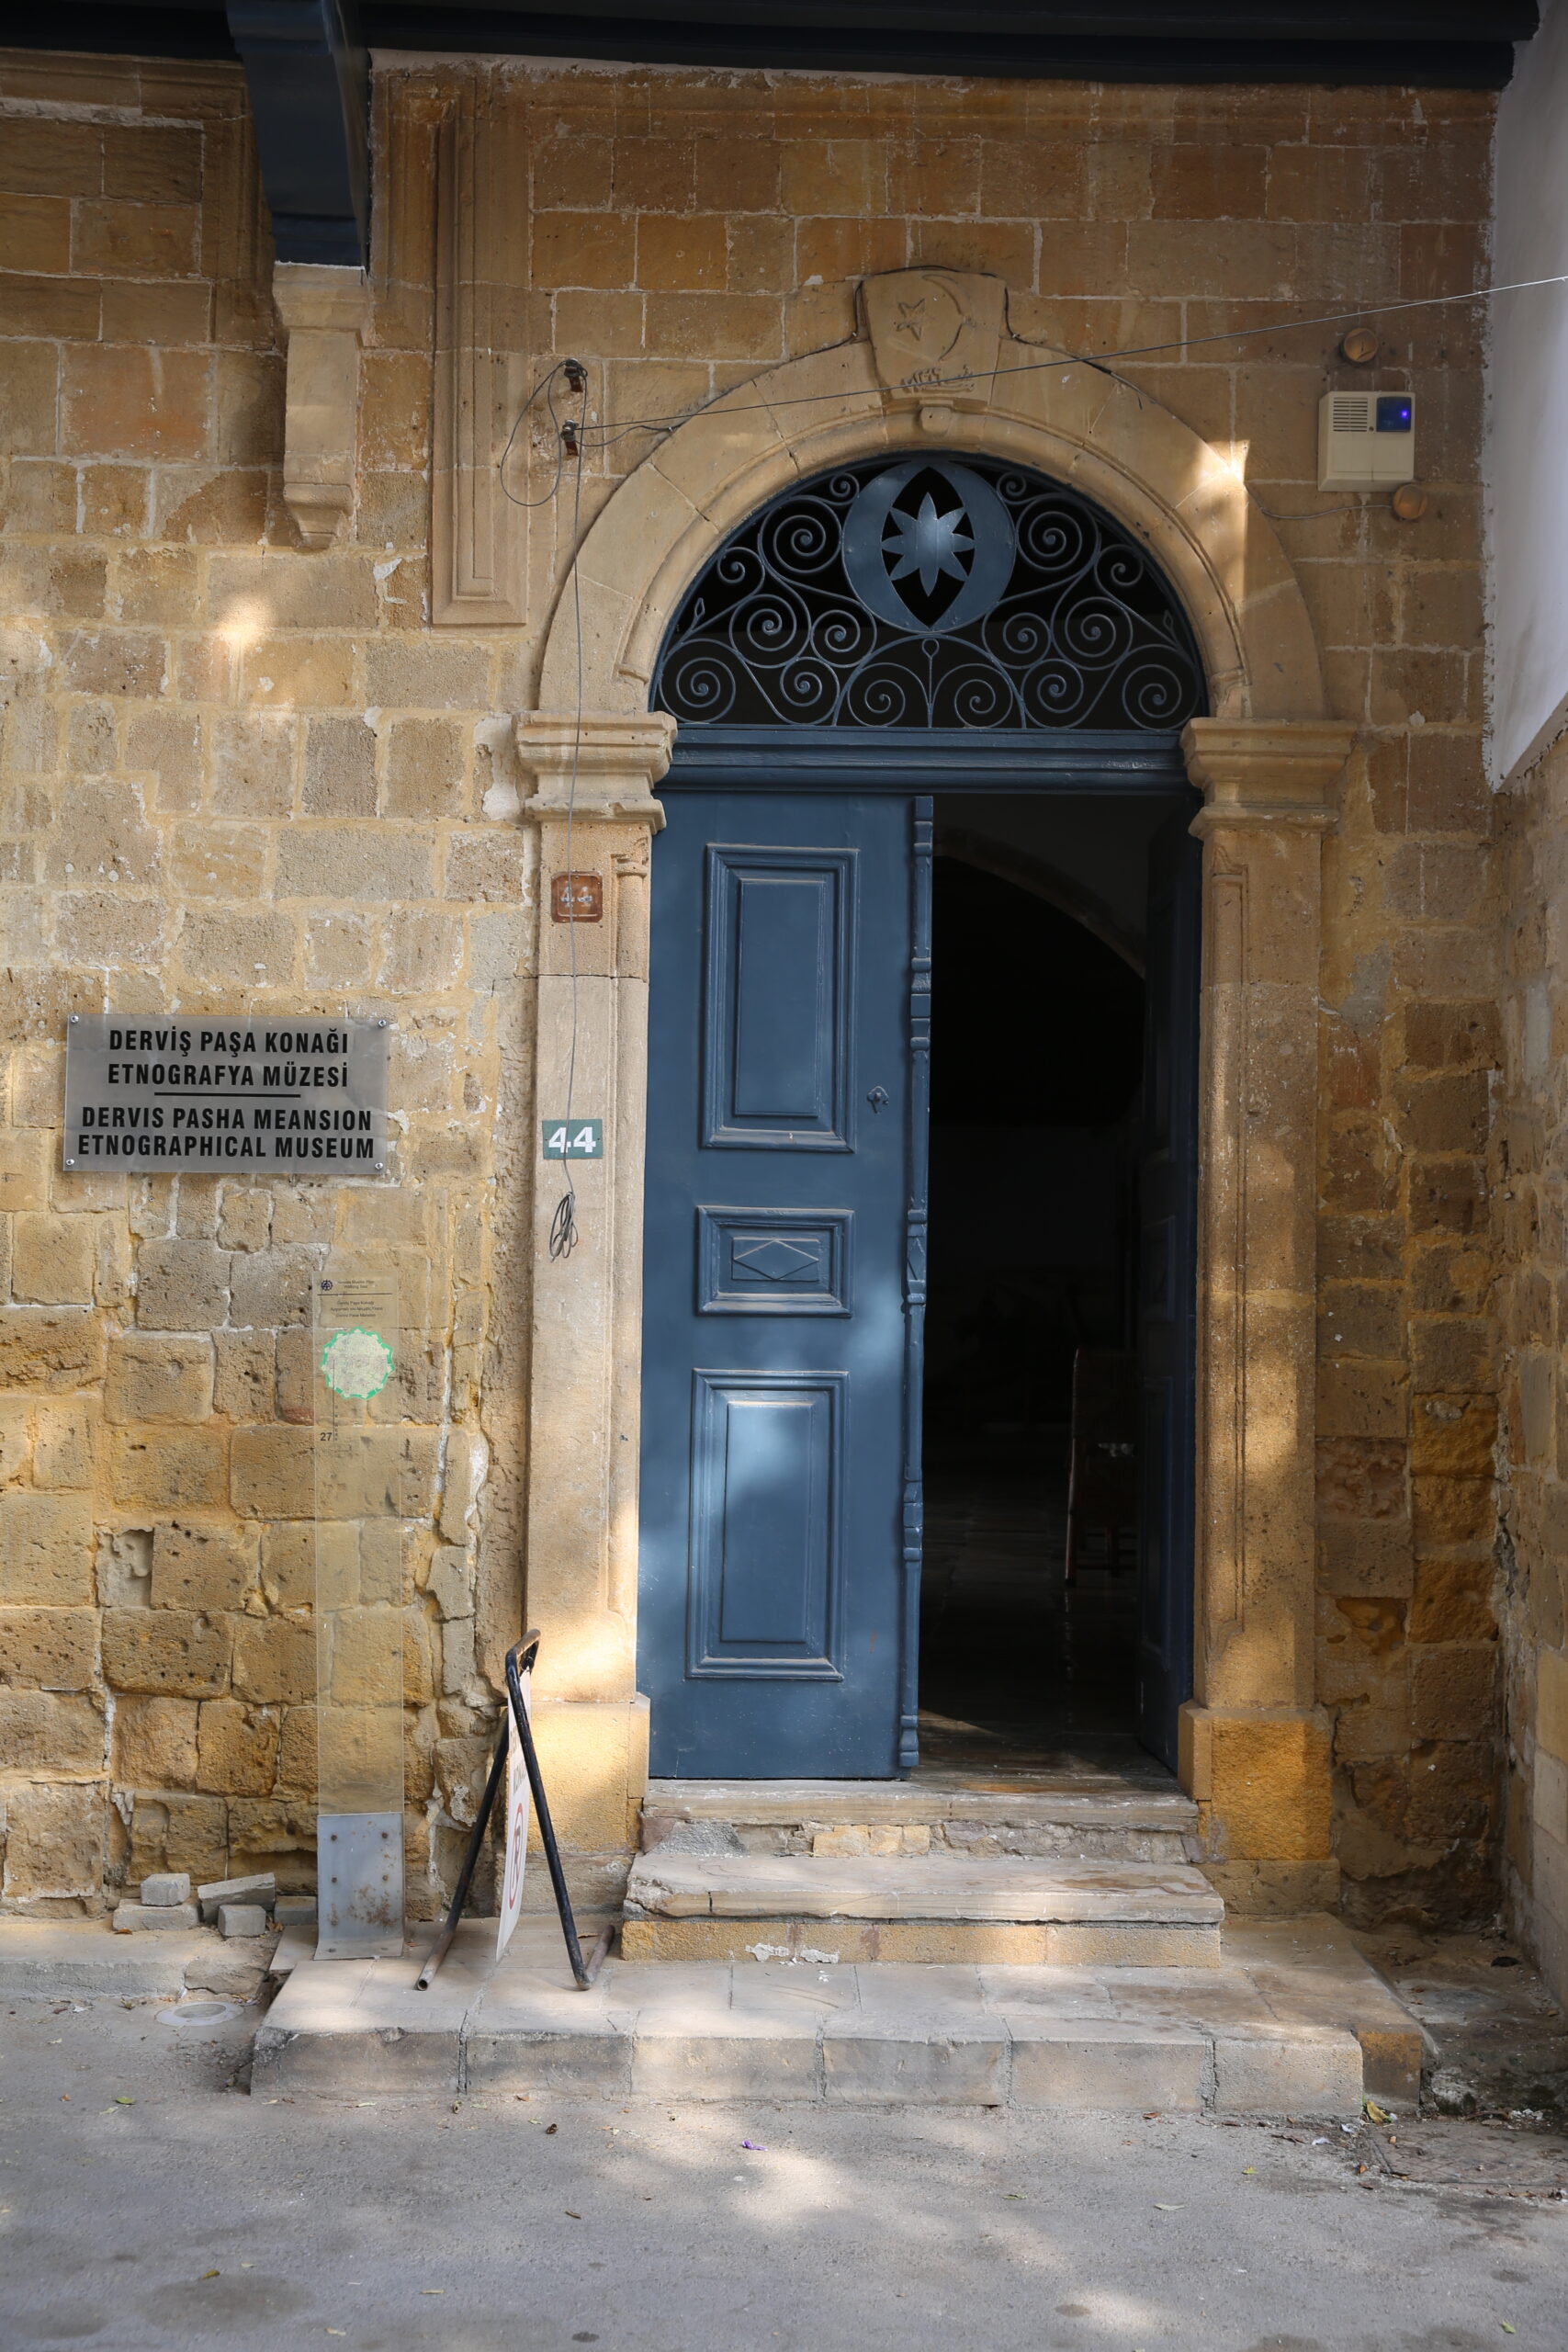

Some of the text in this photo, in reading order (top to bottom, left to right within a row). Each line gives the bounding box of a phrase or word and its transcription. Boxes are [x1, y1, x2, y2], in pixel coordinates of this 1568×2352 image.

[109, 1025, 348, 1057] DERVİŞ PAŞA KONAĞI
[107, 1061, 347, 1087] ETNOGRAFYA MÜZESİ
[82, 1106, 371, 1131] DERVIS PASHA MEANSION
[78, 1135, 374, 1159] ETNOGRAPHICAL MUSEUM
[548, 1126, 597, 1154] 44
[320, 1431, 333, 1442] 27
